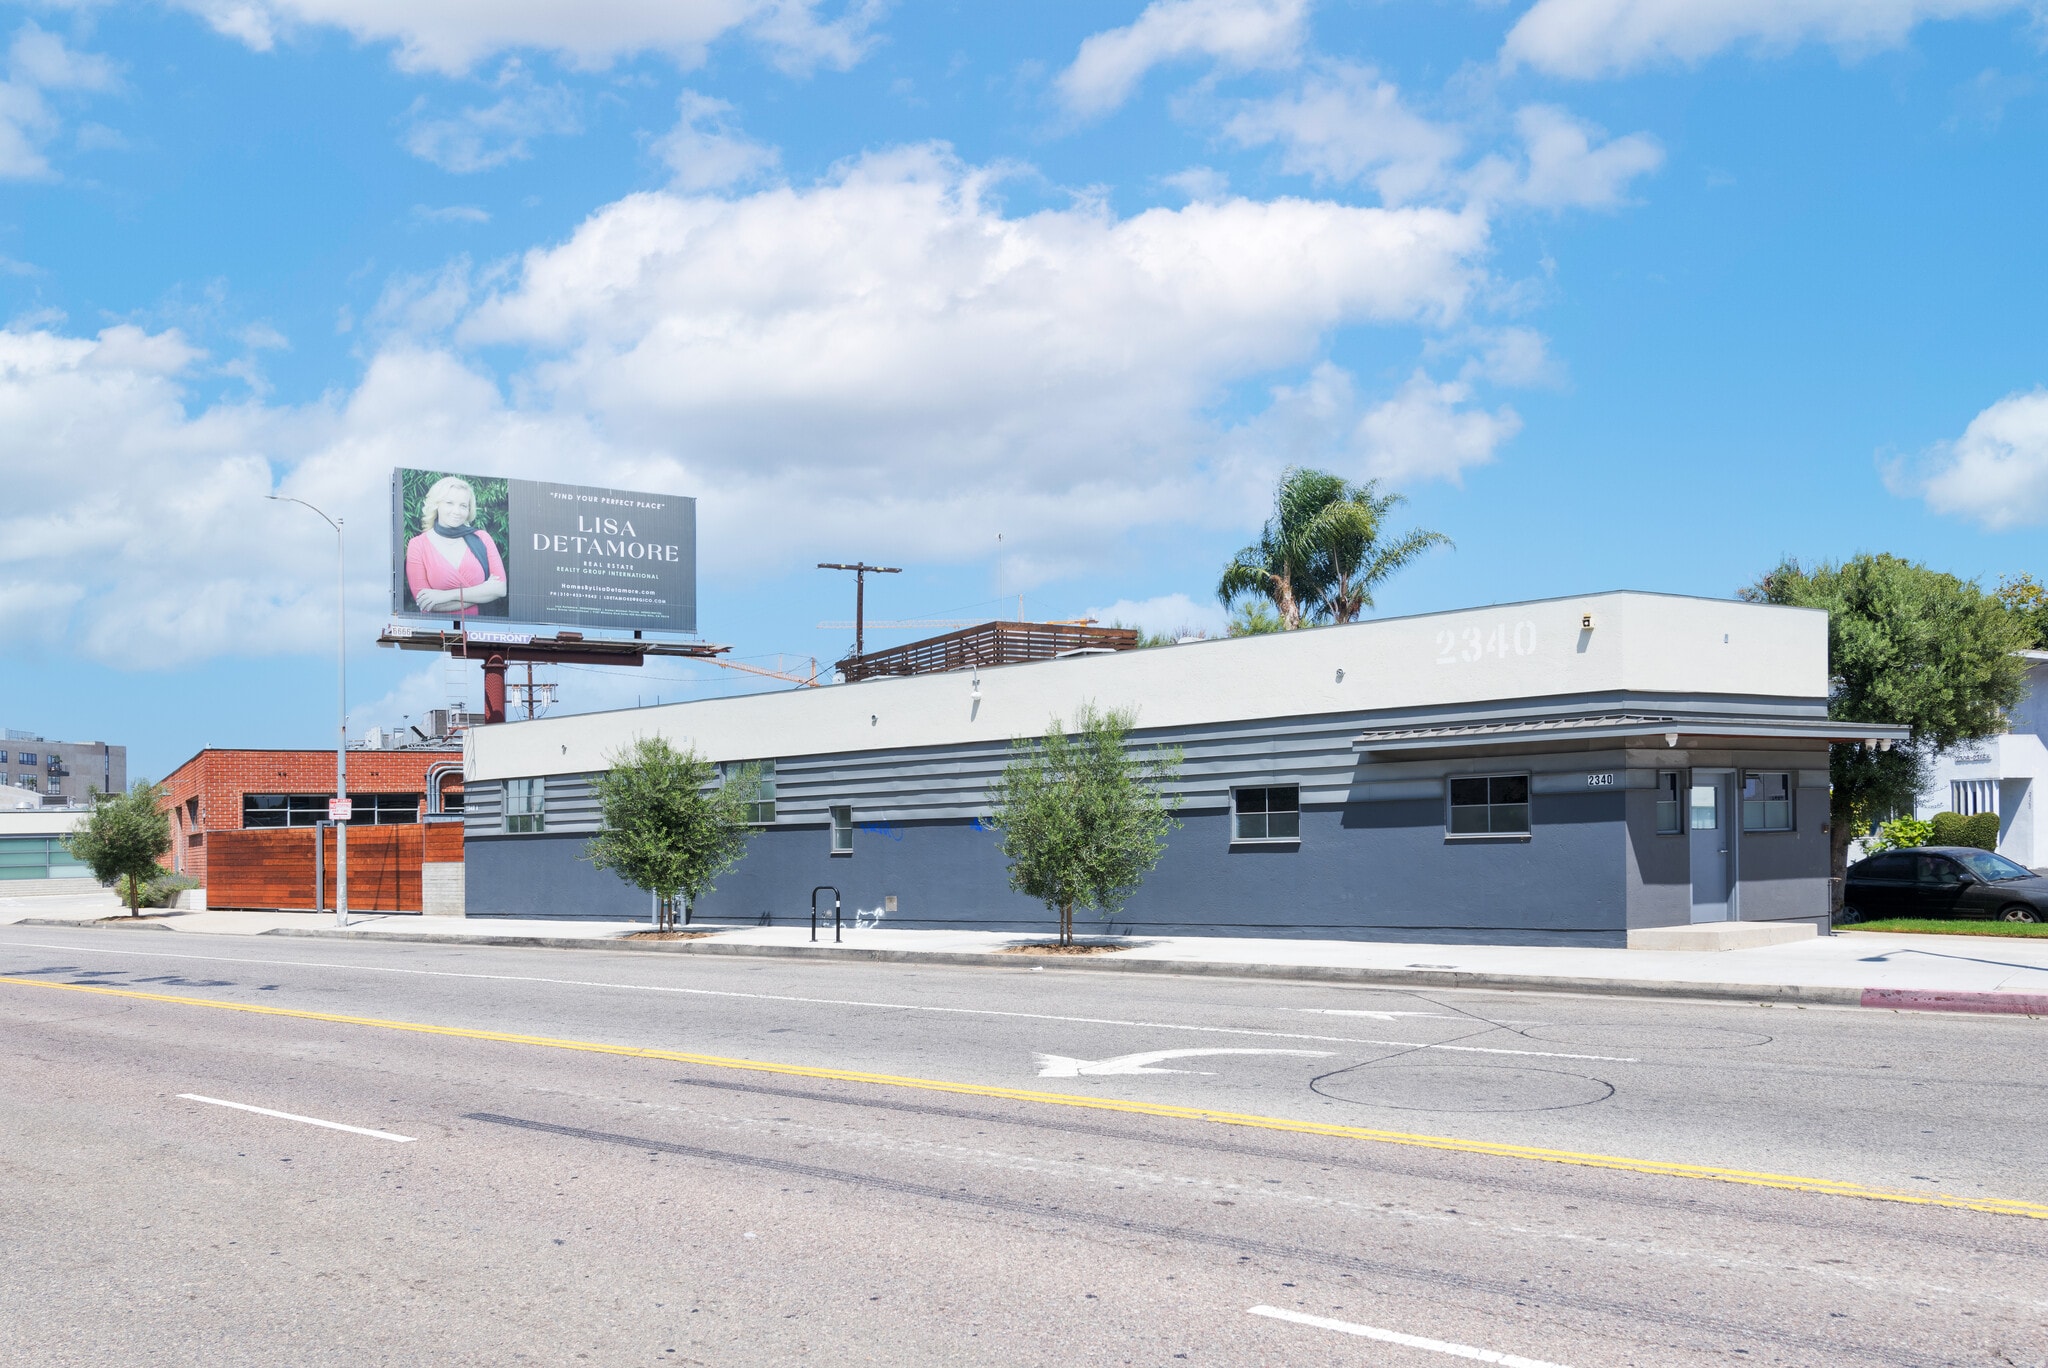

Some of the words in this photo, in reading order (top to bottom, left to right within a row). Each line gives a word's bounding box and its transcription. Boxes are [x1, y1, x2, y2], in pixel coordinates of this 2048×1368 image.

[576, 495, 598, 503] YOUR
[601, 497, 634, 507] PERFECT
[578, 515, 637, 537] LISA
[533, 533, 679, 562] DETAMORE
[556, 566, 580, 574] REALTY
[582, 568, 606, 576] GROUP
[608, 570, 660, 580] INTERNATIONAL
[607, 562, 634, 571] ESTATE
[561, 583, 656, 596] HomesByLisaDetamore.com
[470, 633, 529, 642] OUTFRONT
[1435, 619, 1537, 665] 2340
[1588, 775, 1613, 785] 2340
